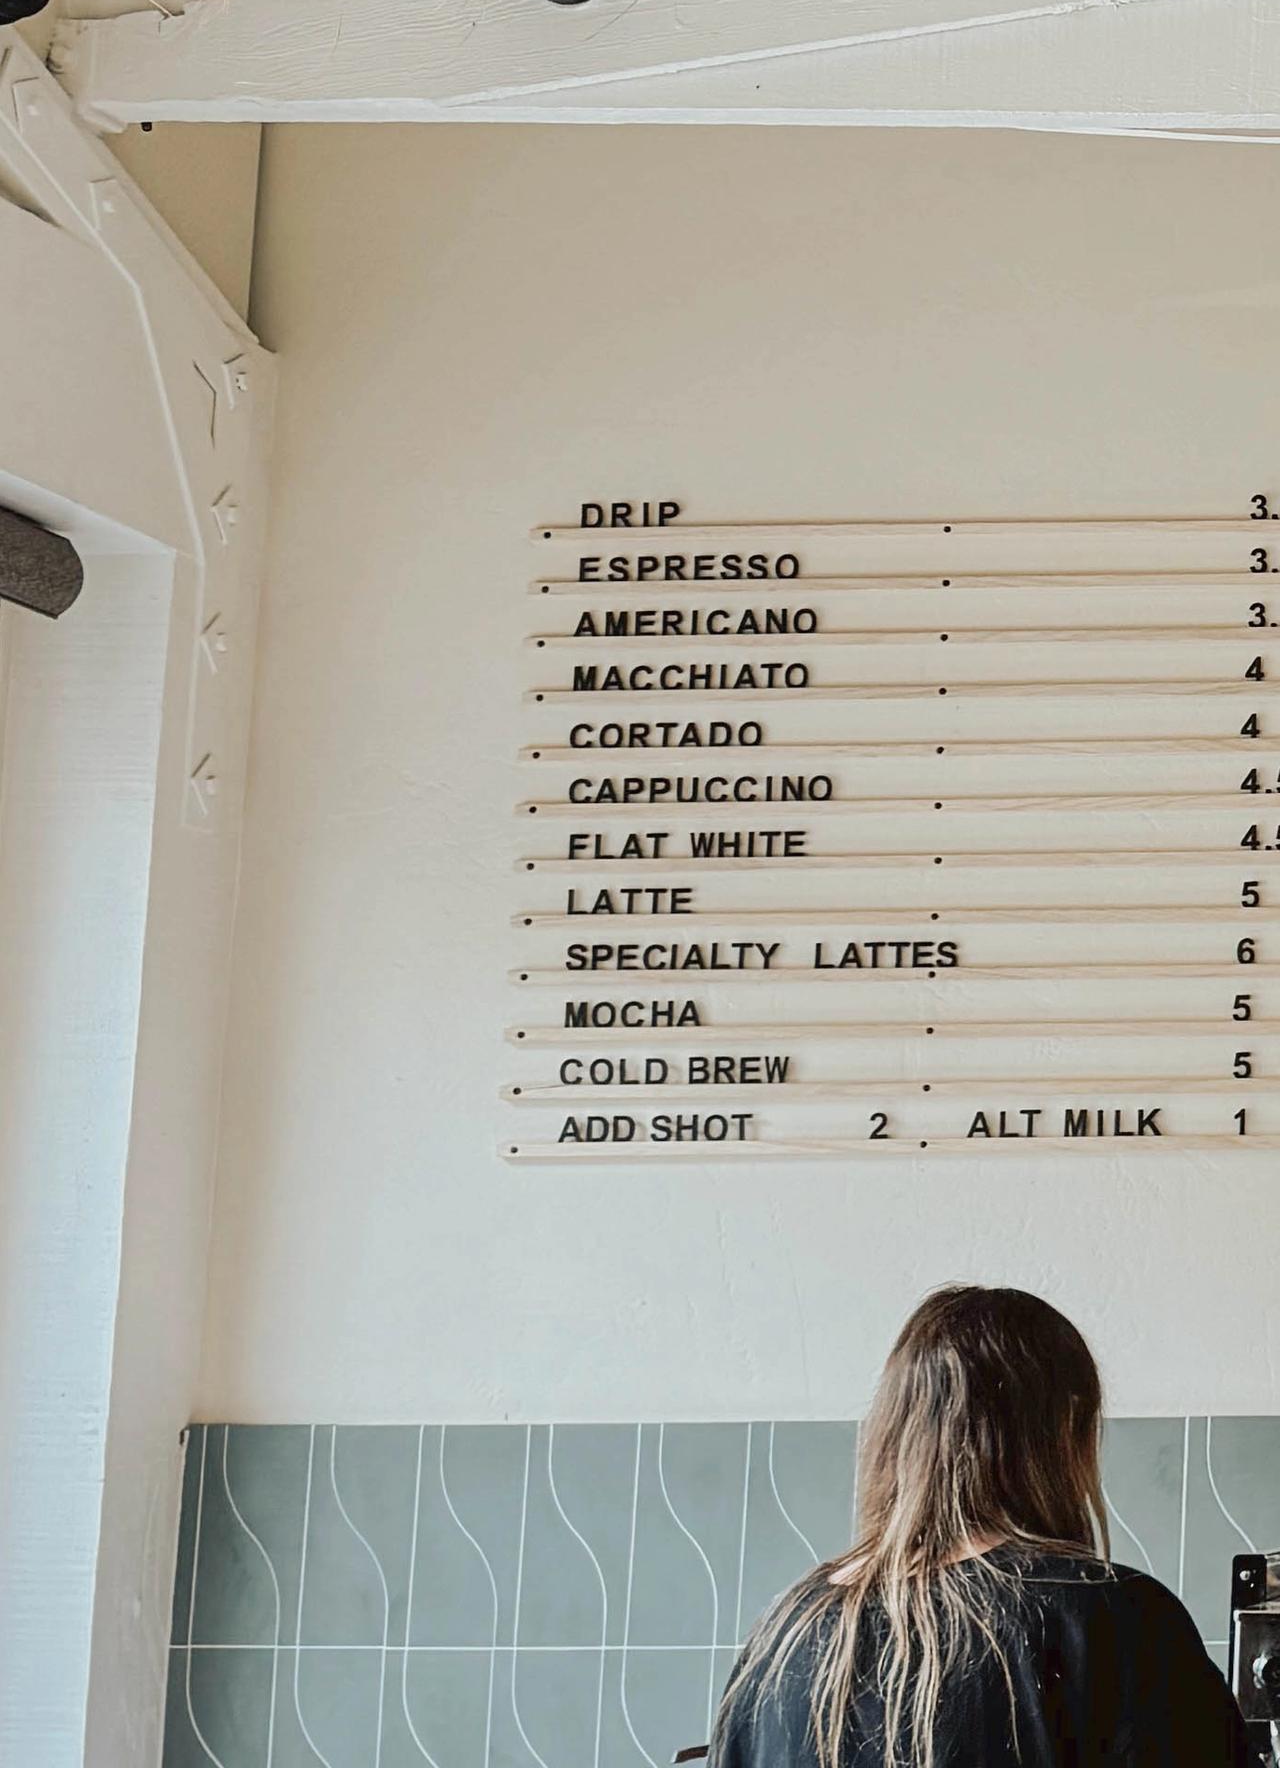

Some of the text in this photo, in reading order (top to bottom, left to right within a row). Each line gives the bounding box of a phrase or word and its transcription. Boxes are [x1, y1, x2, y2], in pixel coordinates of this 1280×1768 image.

[579, 501, 681, 529] DRIP
[575, 553, 801, 583] ESPRESSO
[570, 608, 819, 638] AMERICANO
[571, 656, 1266, 692] MACCHIATO 4
[569, 713, 1262, 749] CORTADO 4
[568, 775, 835, 804] CAPPUCCINO
[567, 832, 670, 861] FLAT
[690, 830, 810, 859] WHITE
[566, 880, 1261, 916] LATTE 5
[565, 937, 1257, 971] SPECIALTY LATTES 6
[564, 994, 1252, 1028] MOCHA 5
[559, 1051, 1252, 1086] COLD BREW 5
[558, 1108, 1246, 1143] ADD SHOT 2 ALT MILK 1
